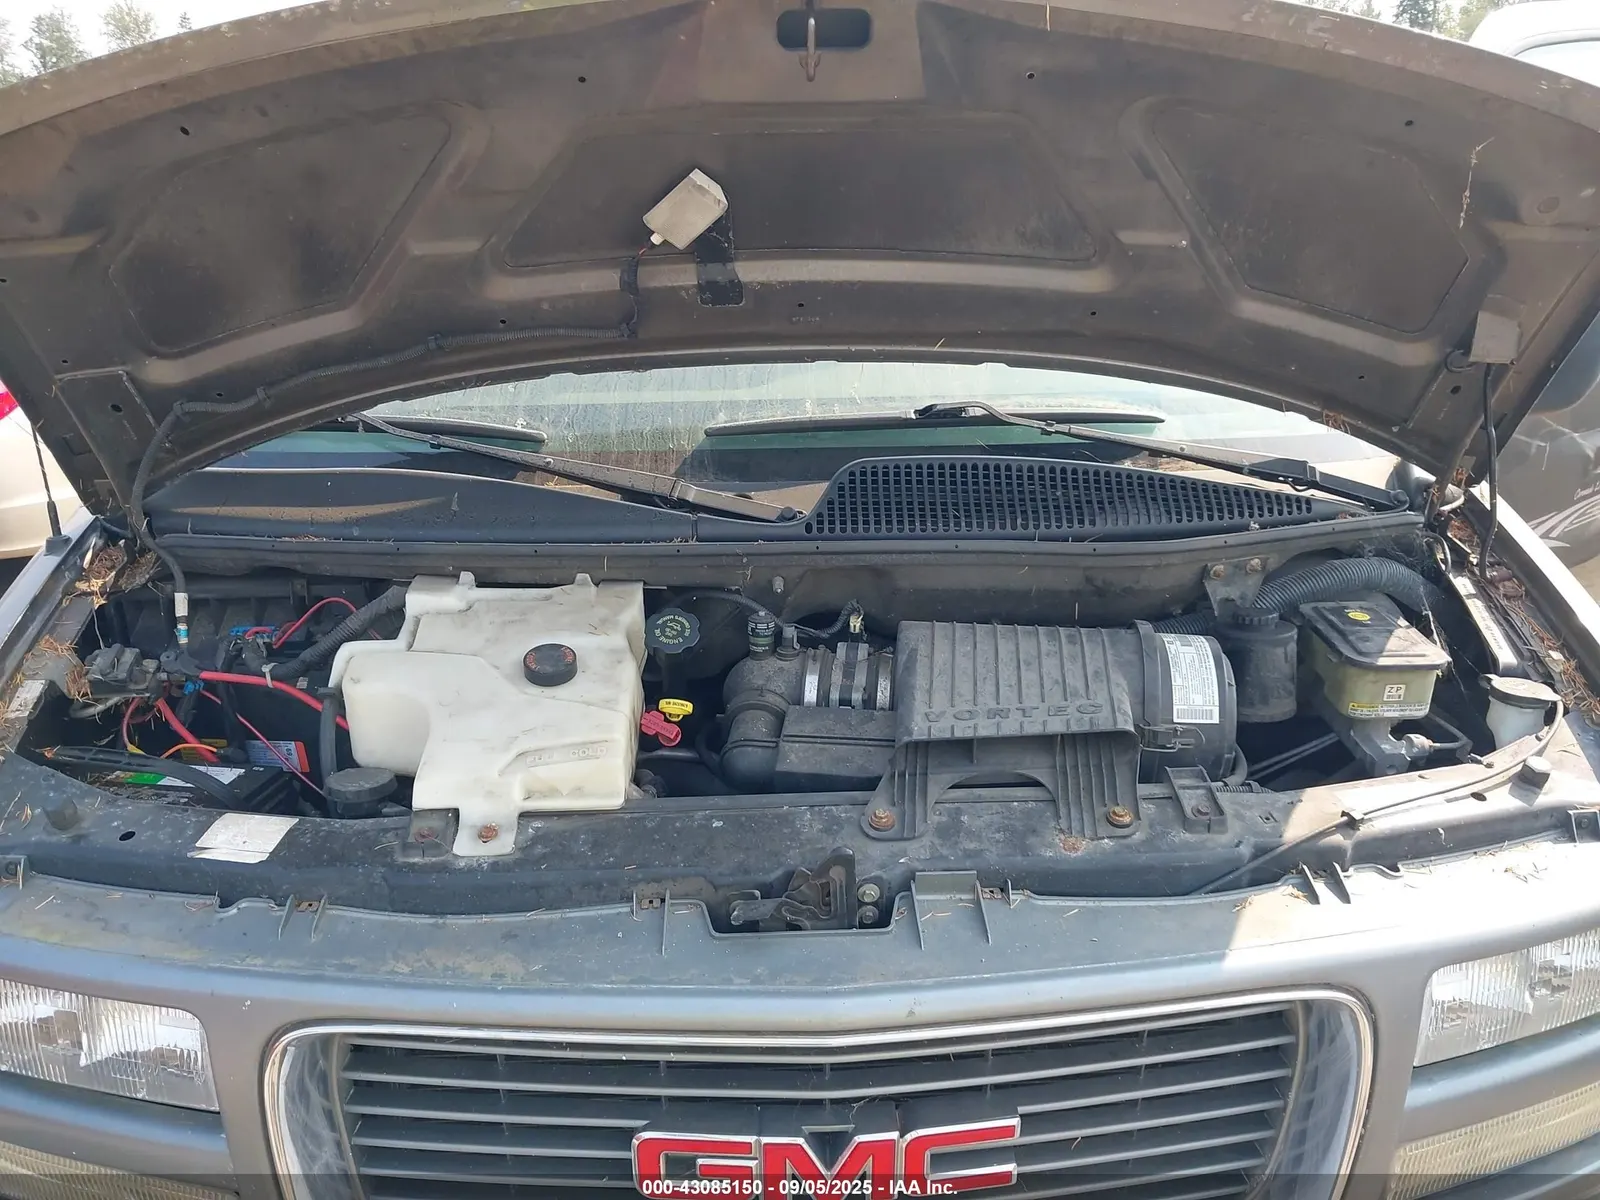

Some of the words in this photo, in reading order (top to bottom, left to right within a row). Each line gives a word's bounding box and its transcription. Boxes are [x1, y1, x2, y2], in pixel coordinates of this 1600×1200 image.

[658, 636, 684, 645] ENGINE
[924, 702, 1104, 723] VORTEC
[631, 1115, 1021, 1200] GMC
